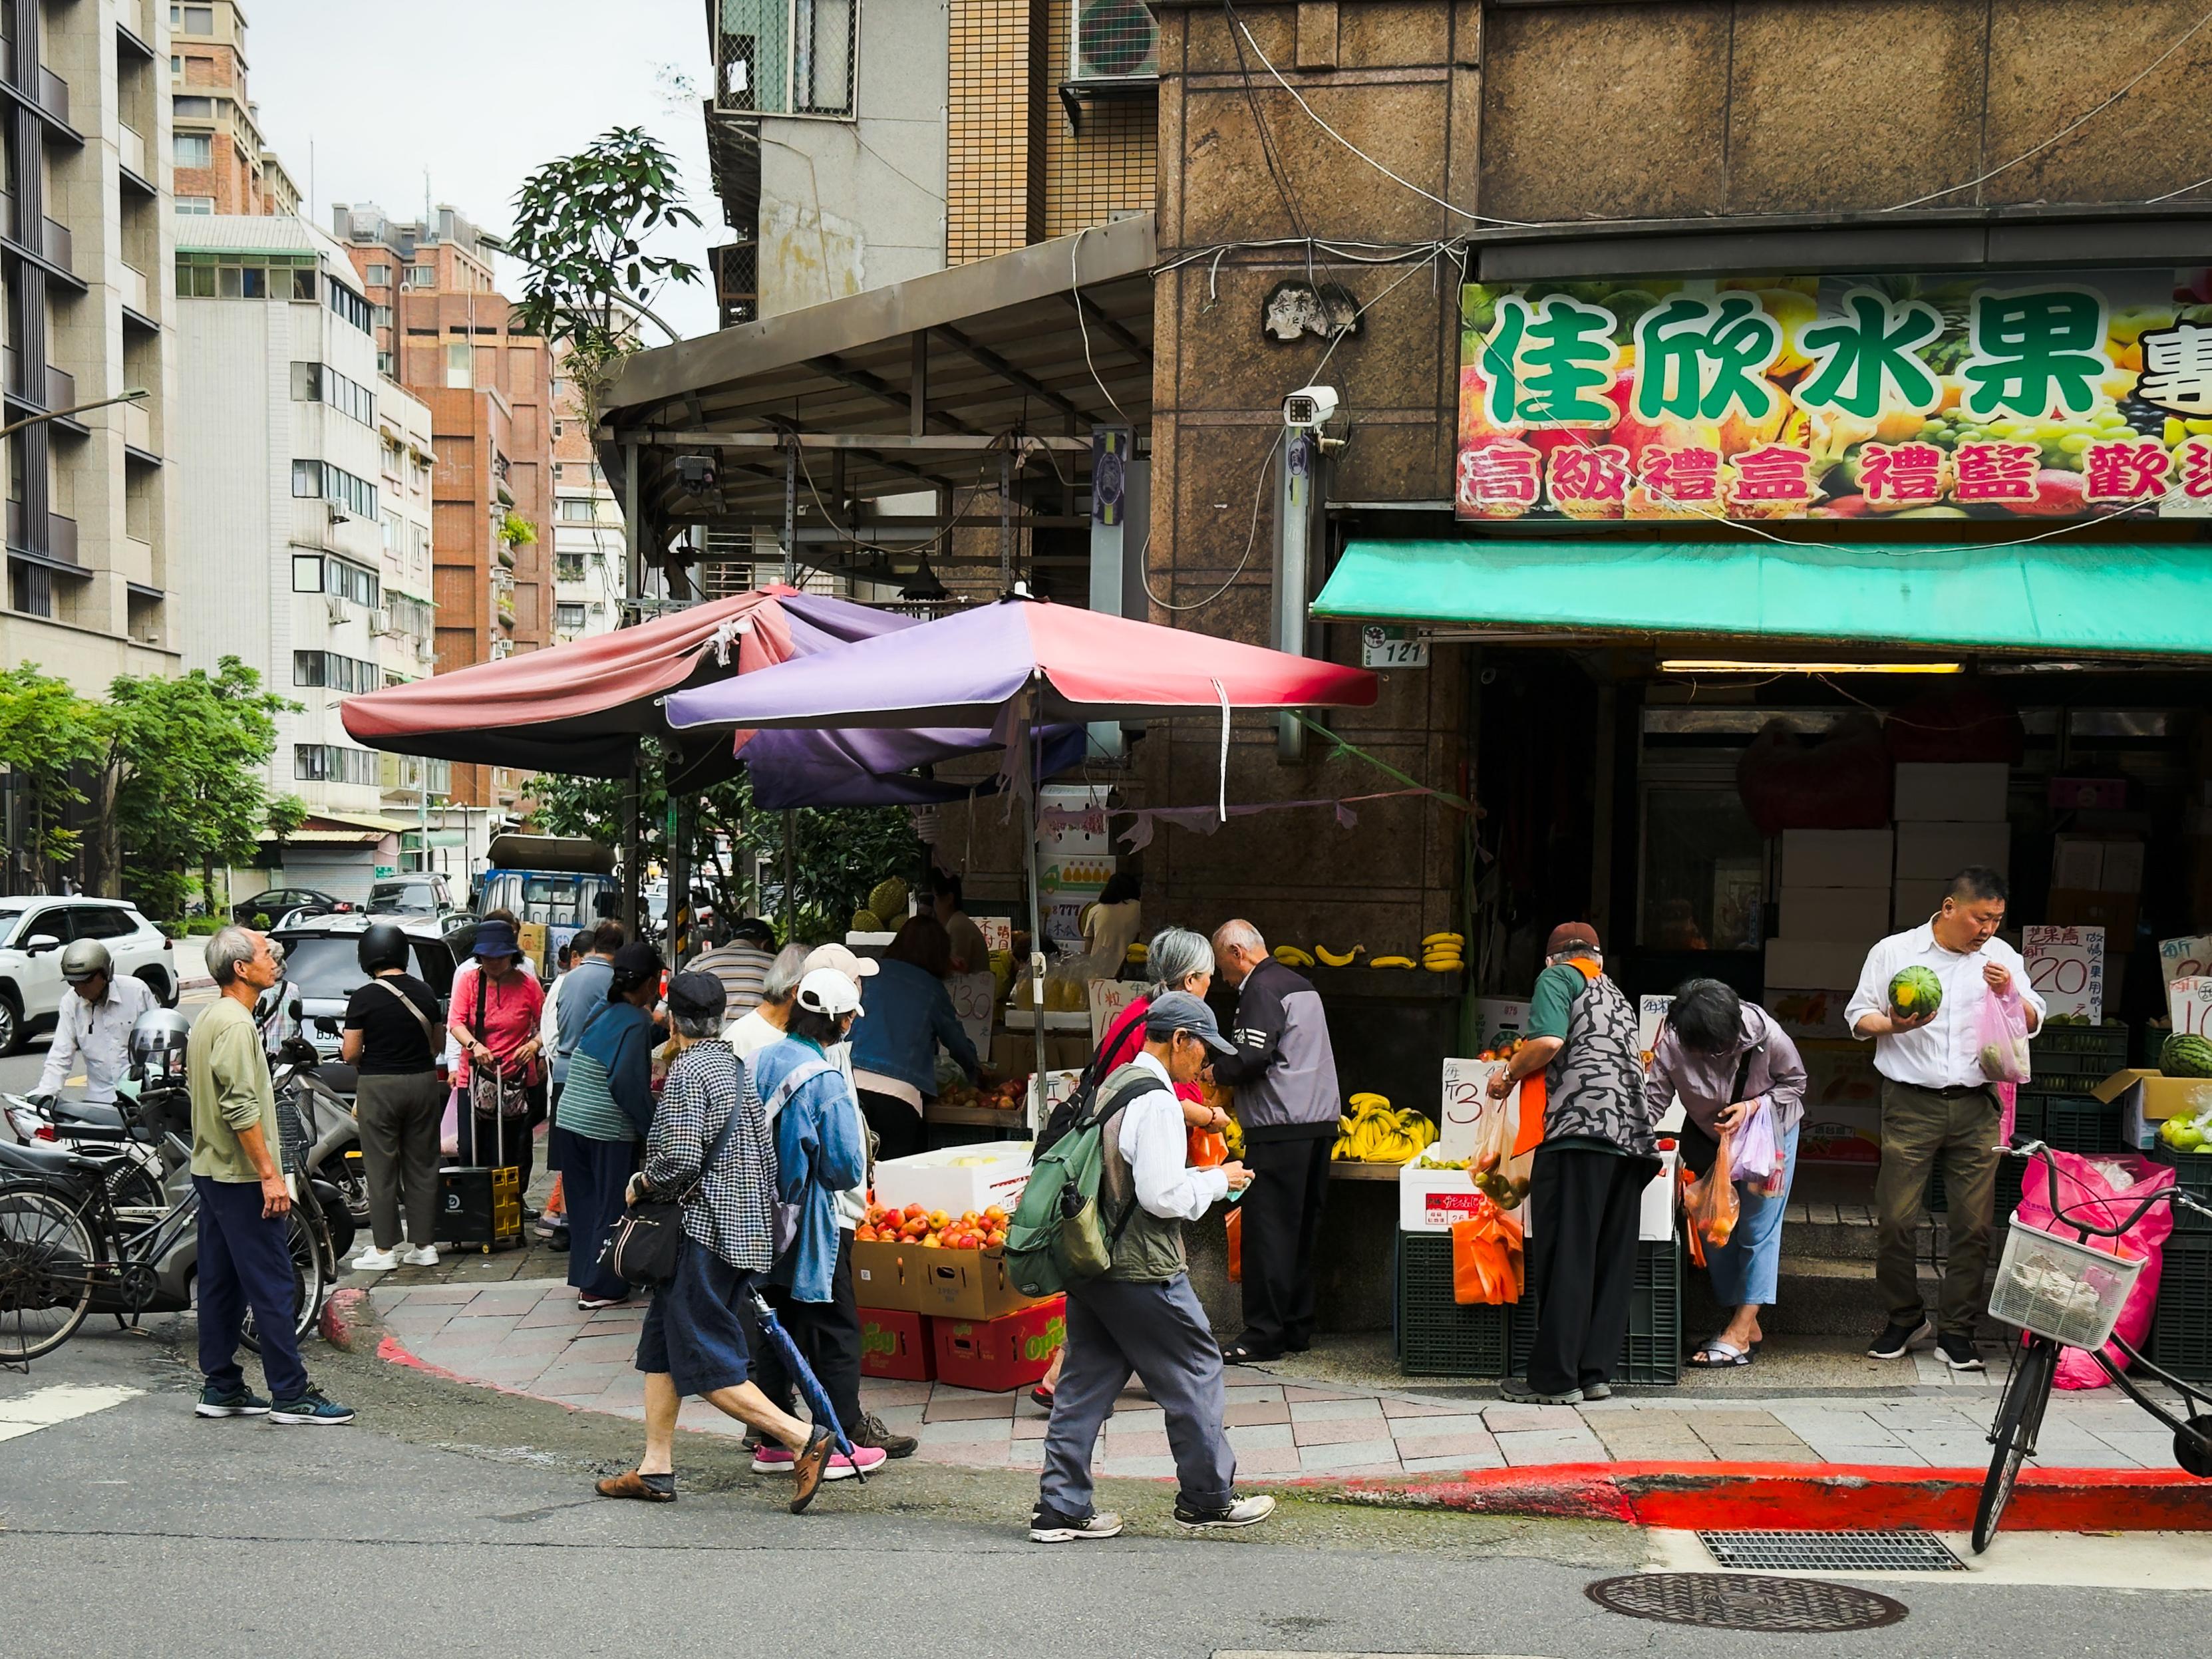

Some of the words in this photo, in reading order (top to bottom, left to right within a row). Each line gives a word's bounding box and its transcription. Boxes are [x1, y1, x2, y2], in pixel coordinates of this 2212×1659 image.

[1481, 291, 2106, 424] 佳欣水果
[1466, 446, 1813, 502] 高級禮盒
[1860, 443, 2038, 500] 禮籃
[1387, 643, 1422, 662] 121
[2030, 957, 2088, 994] 20
